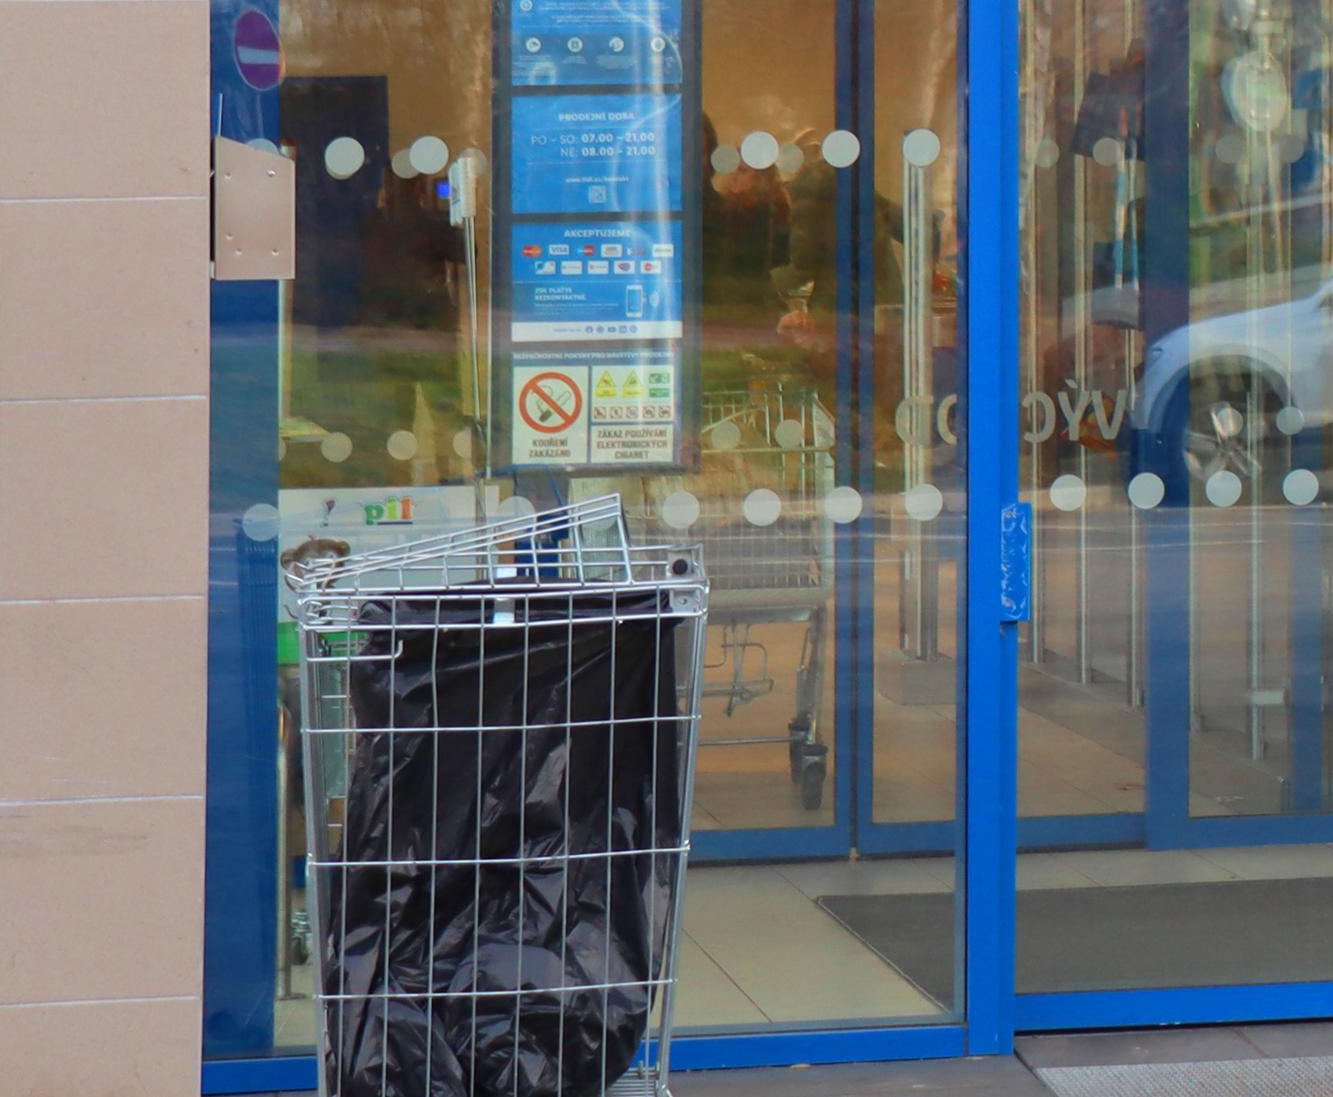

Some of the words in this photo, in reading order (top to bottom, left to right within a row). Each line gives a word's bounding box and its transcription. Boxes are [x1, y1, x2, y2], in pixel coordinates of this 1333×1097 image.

[531, 135, 548, 145] PO
[581, 134, 614, 143] 07.00
[625, 133, 656, 142] 21.00
[581, 147, 614, 156] 08.00
[626, 146, 656, 155] 21.00
